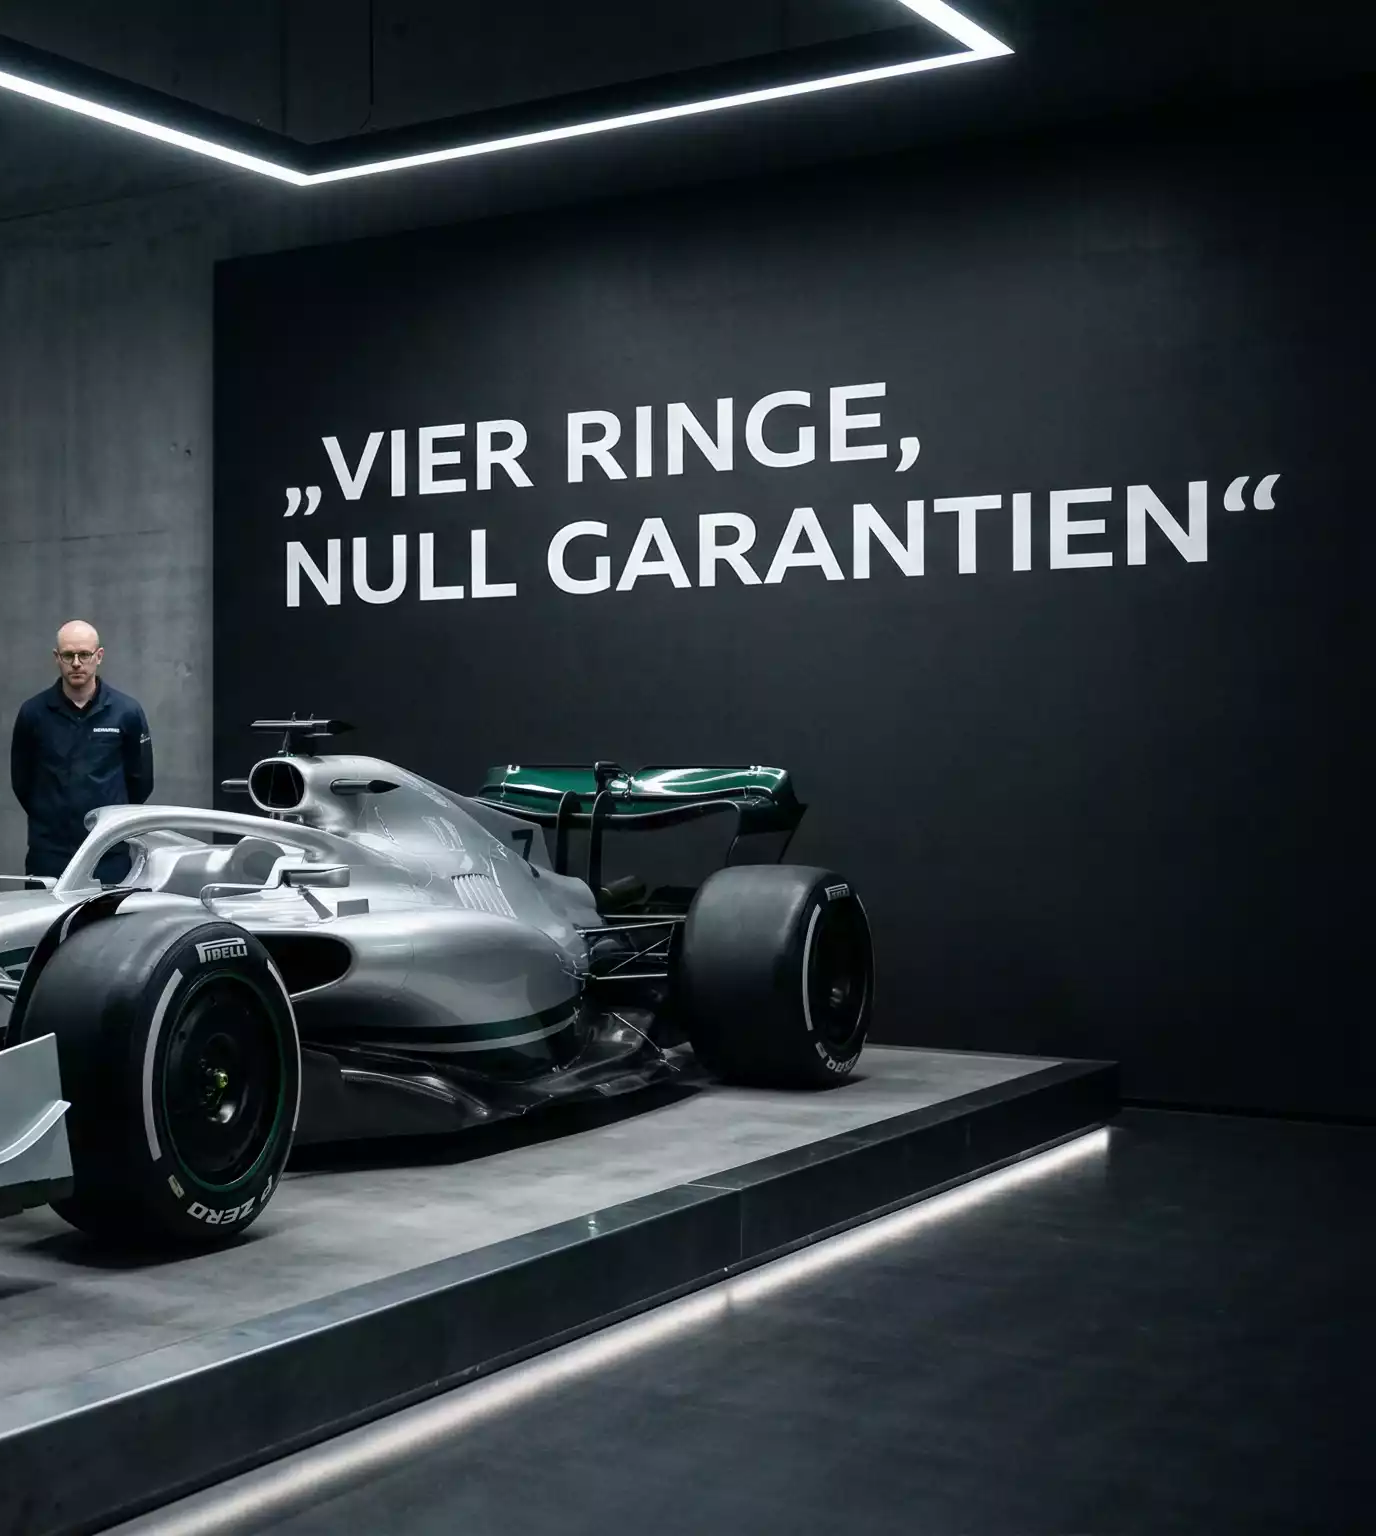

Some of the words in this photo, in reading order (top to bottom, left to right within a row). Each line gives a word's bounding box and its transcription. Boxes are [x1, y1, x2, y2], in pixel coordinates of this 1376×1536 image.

[567, 381, 921, 484] RINGE,
[286, 528, 517, 608] NULL
[186, 1196, 256, 1224] ZERO
[260, 1174, 273, 1202] P
